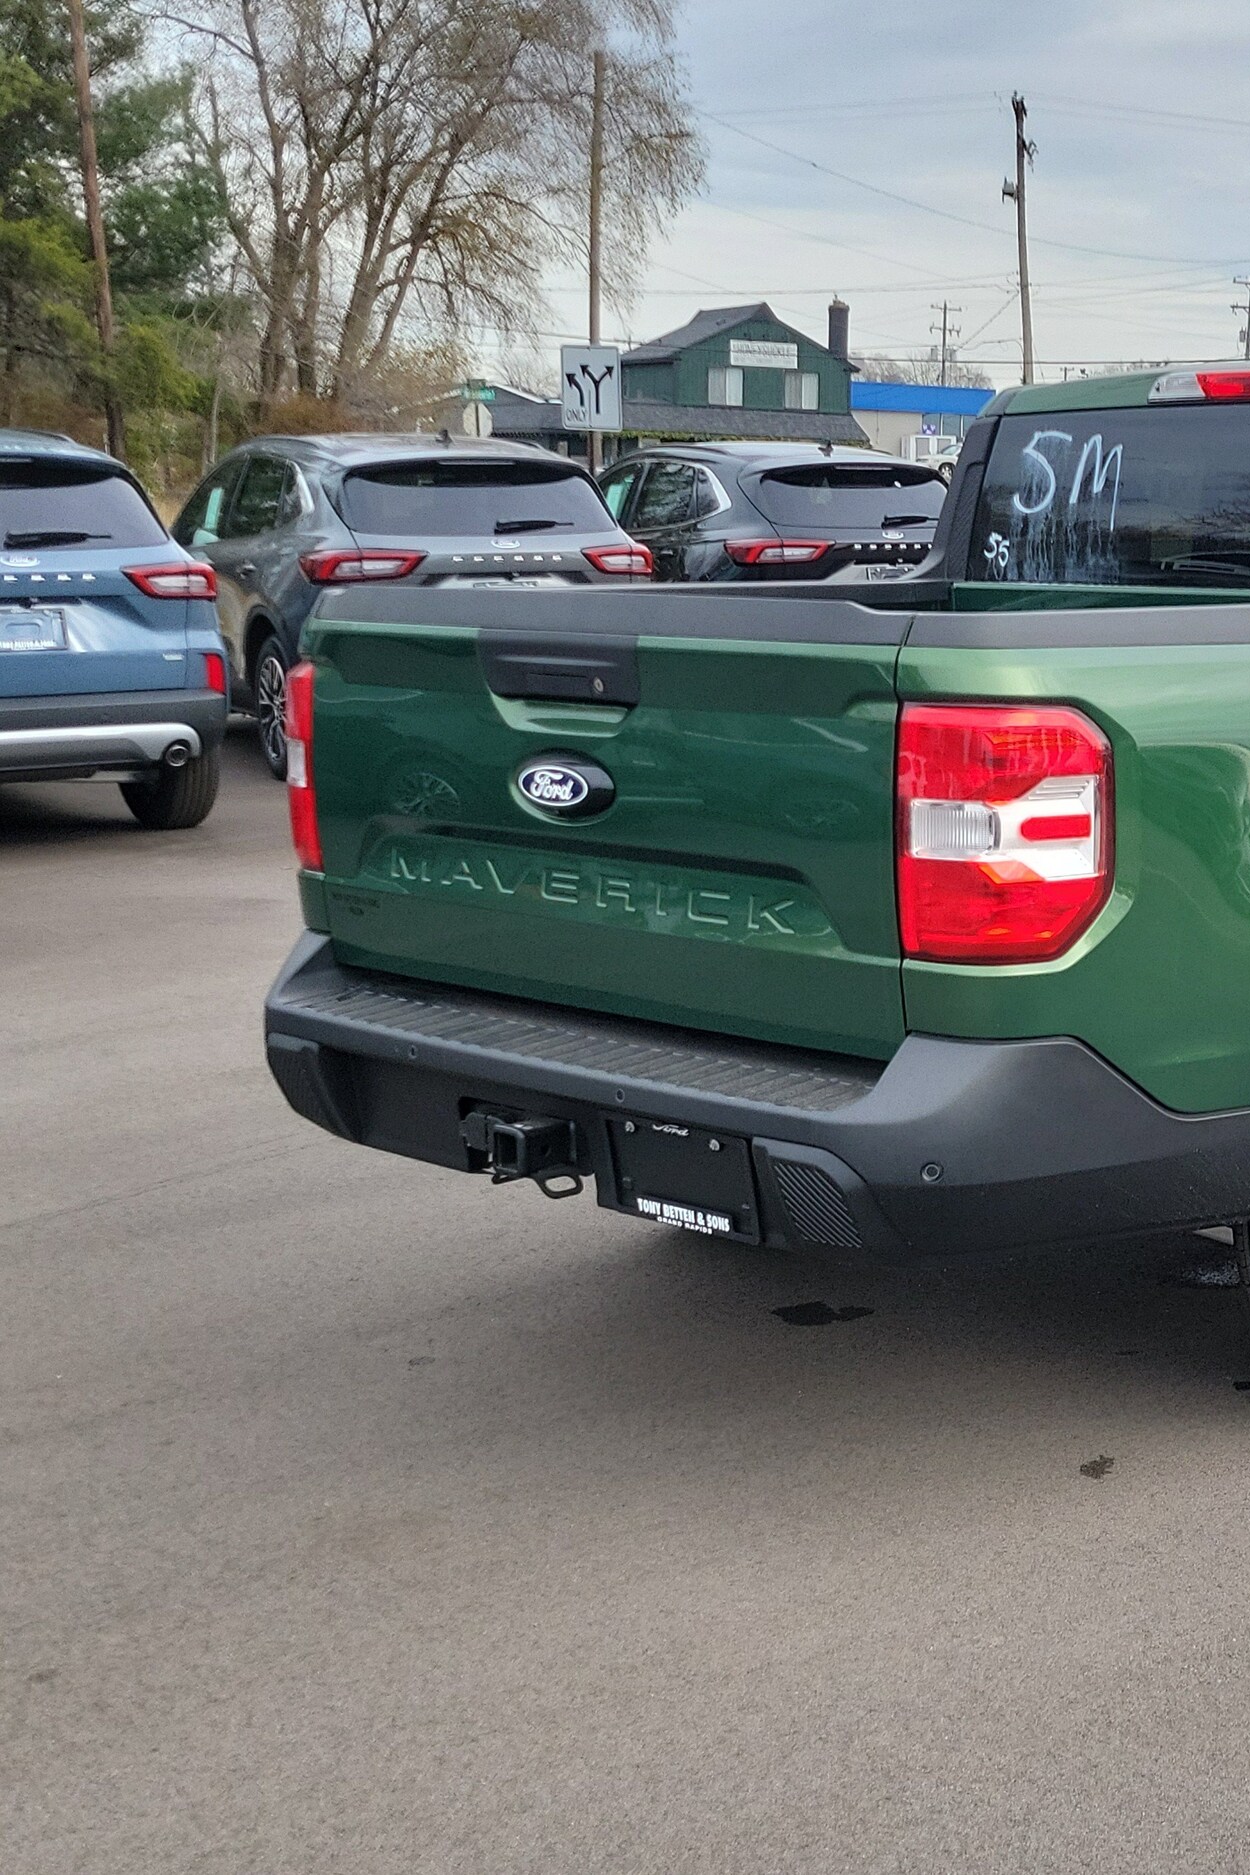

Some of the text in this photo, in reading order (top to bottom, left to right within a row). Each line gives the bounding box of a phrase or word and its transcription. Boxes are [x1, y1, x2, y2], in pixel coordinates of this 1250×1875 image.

[566, 408, 587, 422] ONLY
[530, 771, 575, 801] Ford
[390, 847, 796, 935] MAVERICK
[636, 1198, 730, 1232] TONY BETTEN & SONS
